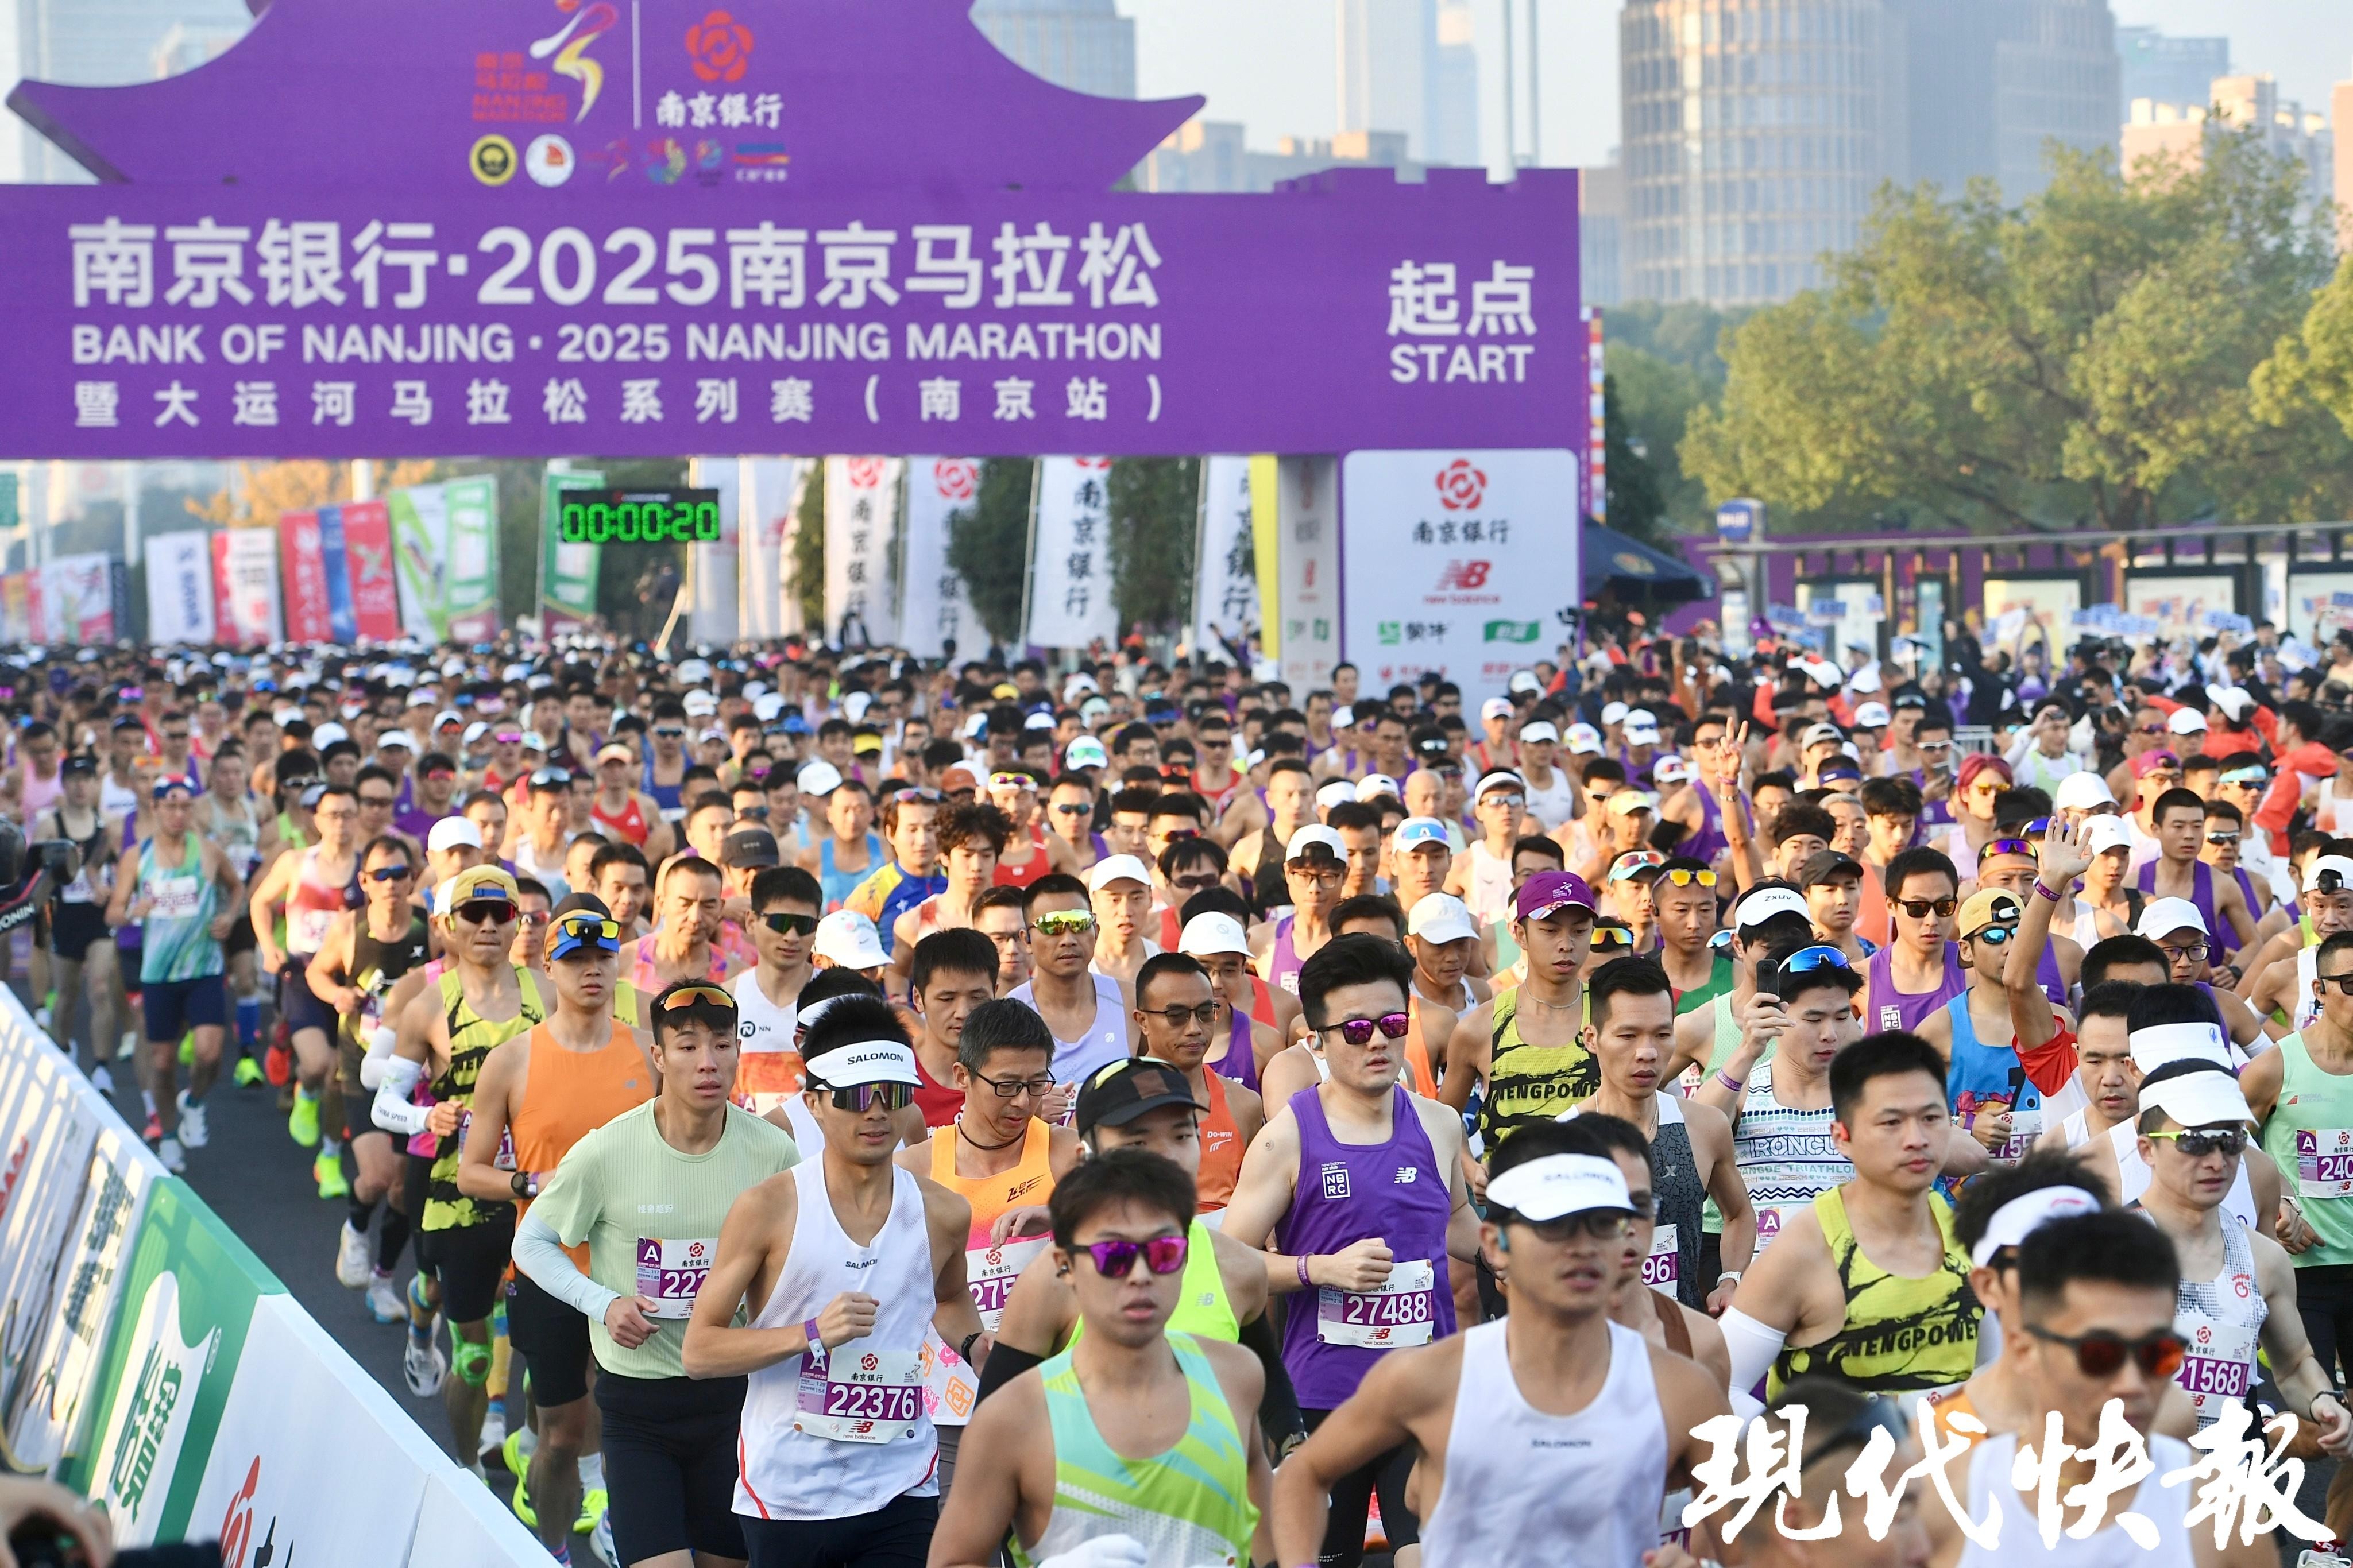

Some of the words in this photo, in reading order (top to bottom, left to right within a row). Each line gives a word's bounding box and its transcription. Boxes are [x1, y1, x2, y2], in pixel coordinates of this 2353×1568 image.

[656, 90, 783, 129] 南京银行
[68, 216, 1161, 310] 南京银行·2025南京马拉松
[1386, 260, 1537, 336] 起点
[72, 324, 205, 365] BANK
[220, 324, 285, 365] OF
[303, 323, 513, 363] NANJING
[557, 323, 670, 363] 2025
[686, 323, 890, 361] NANJING
[906, 323, 1161, 361] MARATHON
[1390, 343, 1535, 384] START
[563, 502, 720, 543] 00:00:20
[1413, 520, 1510, 544] 南京银行
[848, 498, 870, 613] 南京银行
[1065, 480, 1101, 617] 南京银行
[847, 1052, 903, 1065] SALOMON
[2302, 1136, 2315, 1150] A
[1327, 1174, 1345, 1184] NB
[2321, 1156, 2353, 1180] 240
[1327, 1184, 1346, 1194] RC
[1764, 1214, 1778, 1230] A
[644, 1245, 659, 1261] A
[682, 1259, 710, 1268] 南京银行
[981, 1265, 1011, 1277] 南京银行
[1346, 1292, 1427, 1325] 27488
[2186, 1344, 2215, 1357] 南京银行
[851, 1372, 883, 1383] 南京银行
[828, 1384, 915, 1419] 22376
